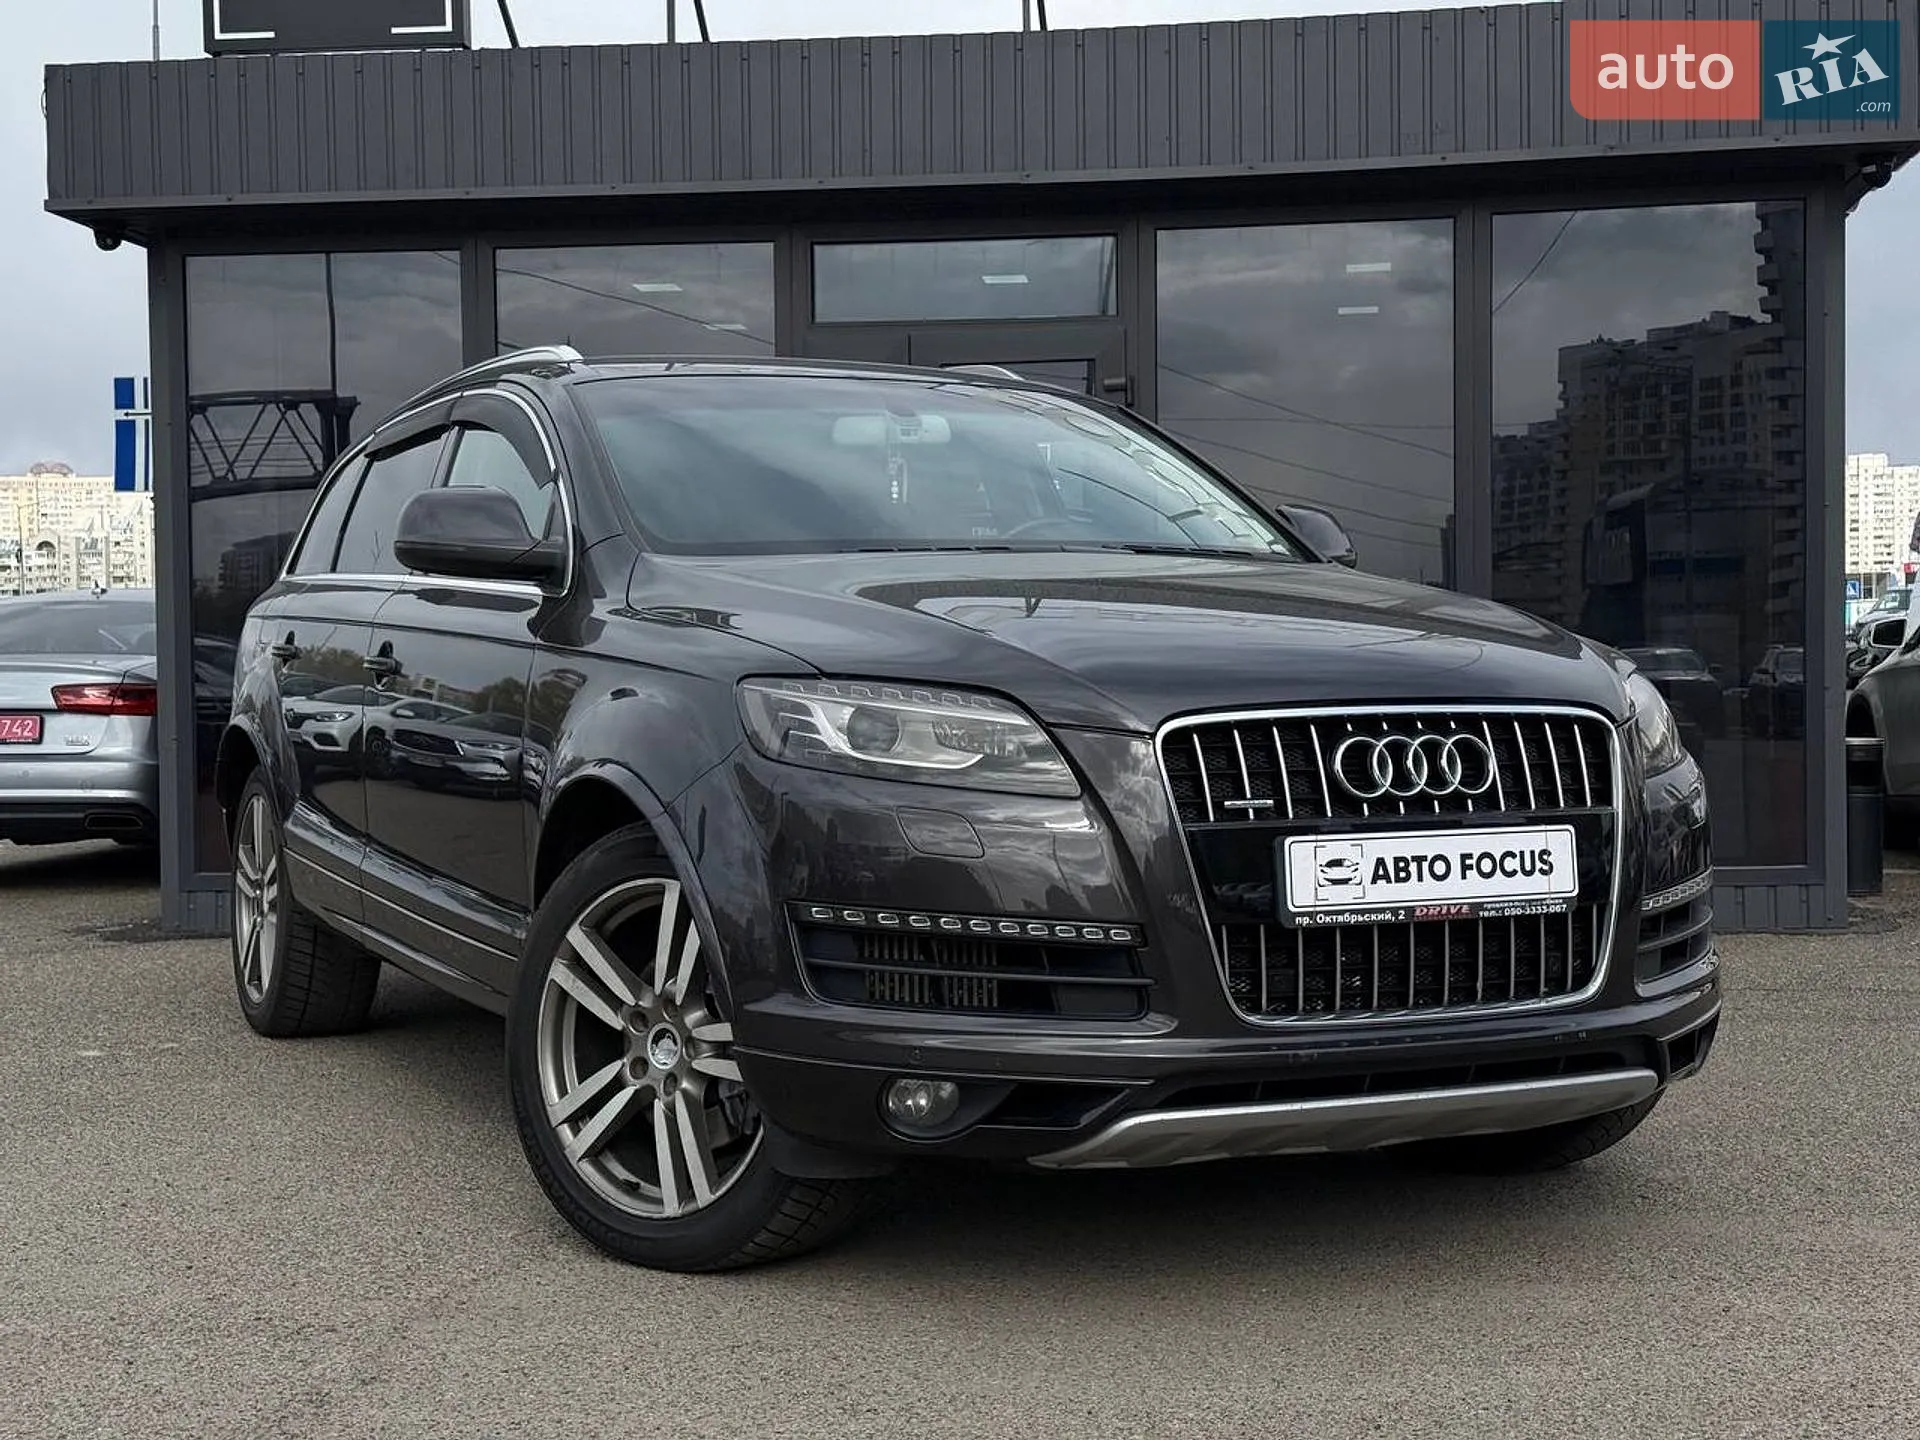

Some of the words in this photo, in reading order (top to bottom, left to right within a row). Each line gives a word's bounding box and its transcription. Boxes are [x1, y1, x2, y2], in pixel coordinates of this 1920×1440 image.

[1, 719, 33, 737] 742
[1370, 853, 1452, 885] АВТО
[1460, 849, 1554, 880] FOCUS
[1295, 916, 1313, 926] пр.
[1316, 910, 1395, 924] Октябрьский,
[1398, 909, 1406, 920] 2
[1414, 904, 1471, 916] DRIVE
